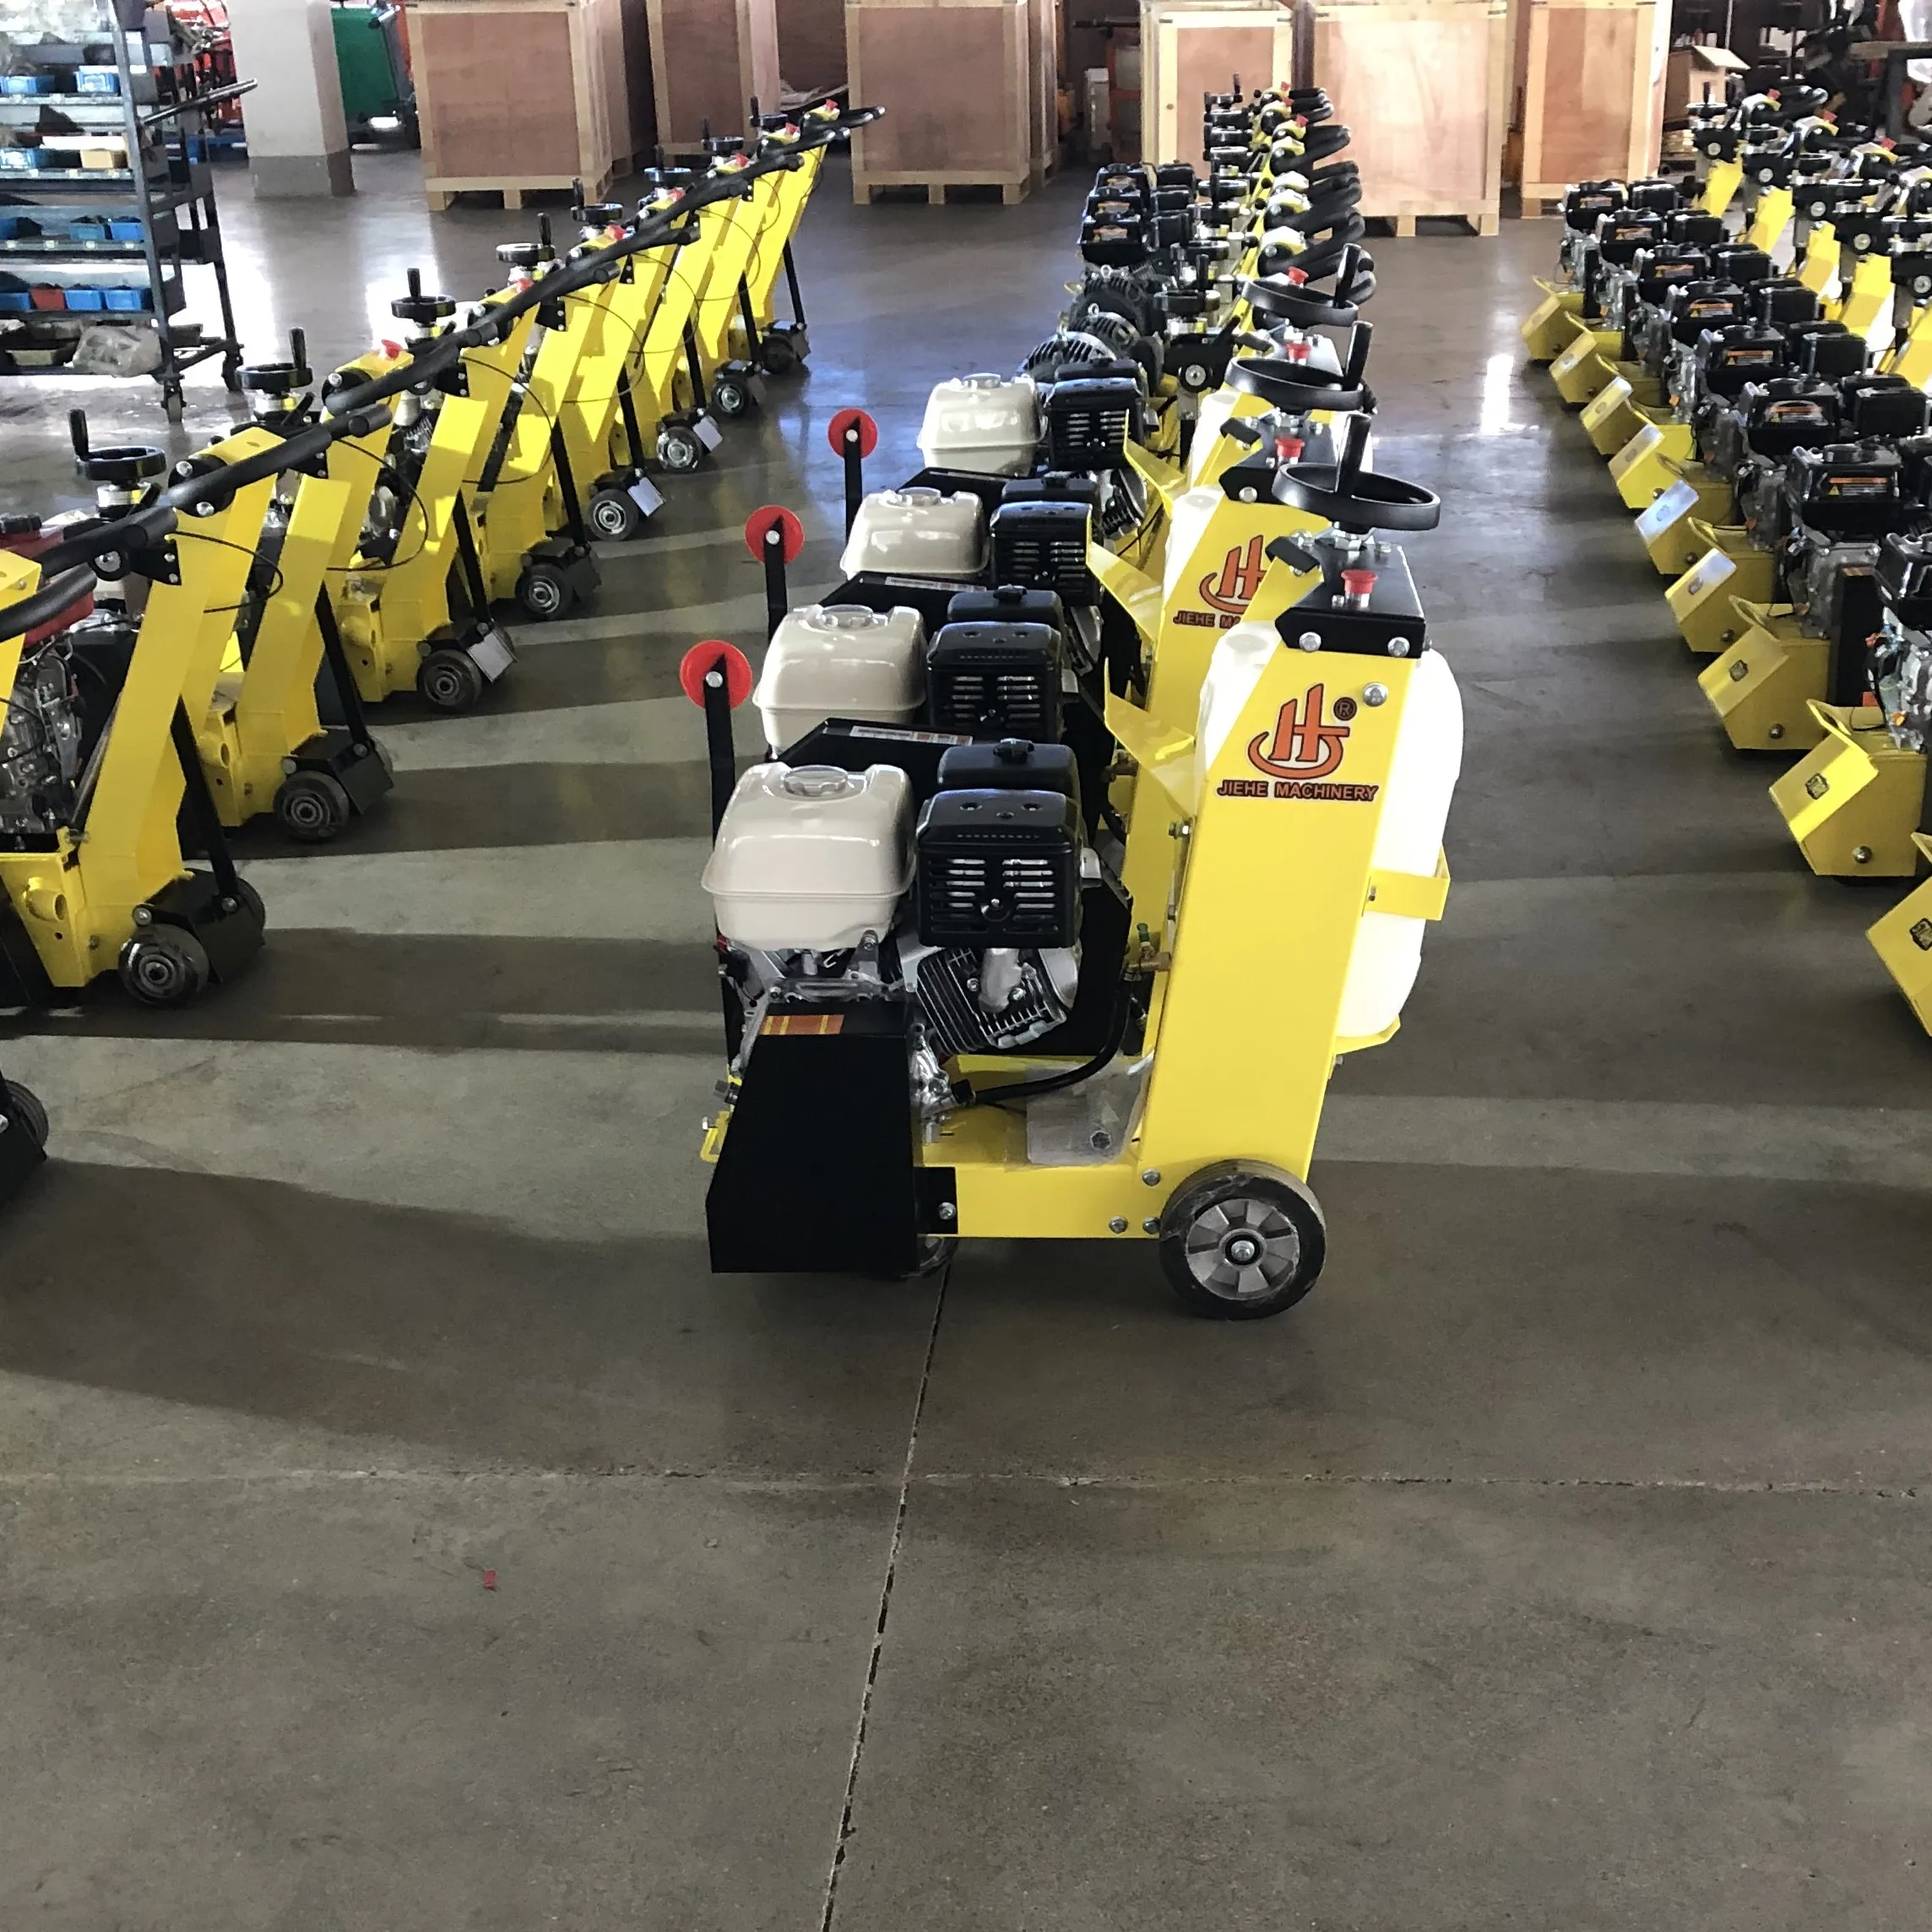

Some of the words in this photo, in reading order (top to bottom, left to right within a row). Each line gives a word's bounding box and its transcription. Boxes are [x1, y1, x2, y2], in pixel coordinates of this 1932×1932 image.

[1173, 610, 1215, 627] JIEHE
[1217, 779, 1268, 797] JIEHE
[1274, 782, 1379, 801] MACHINERY
